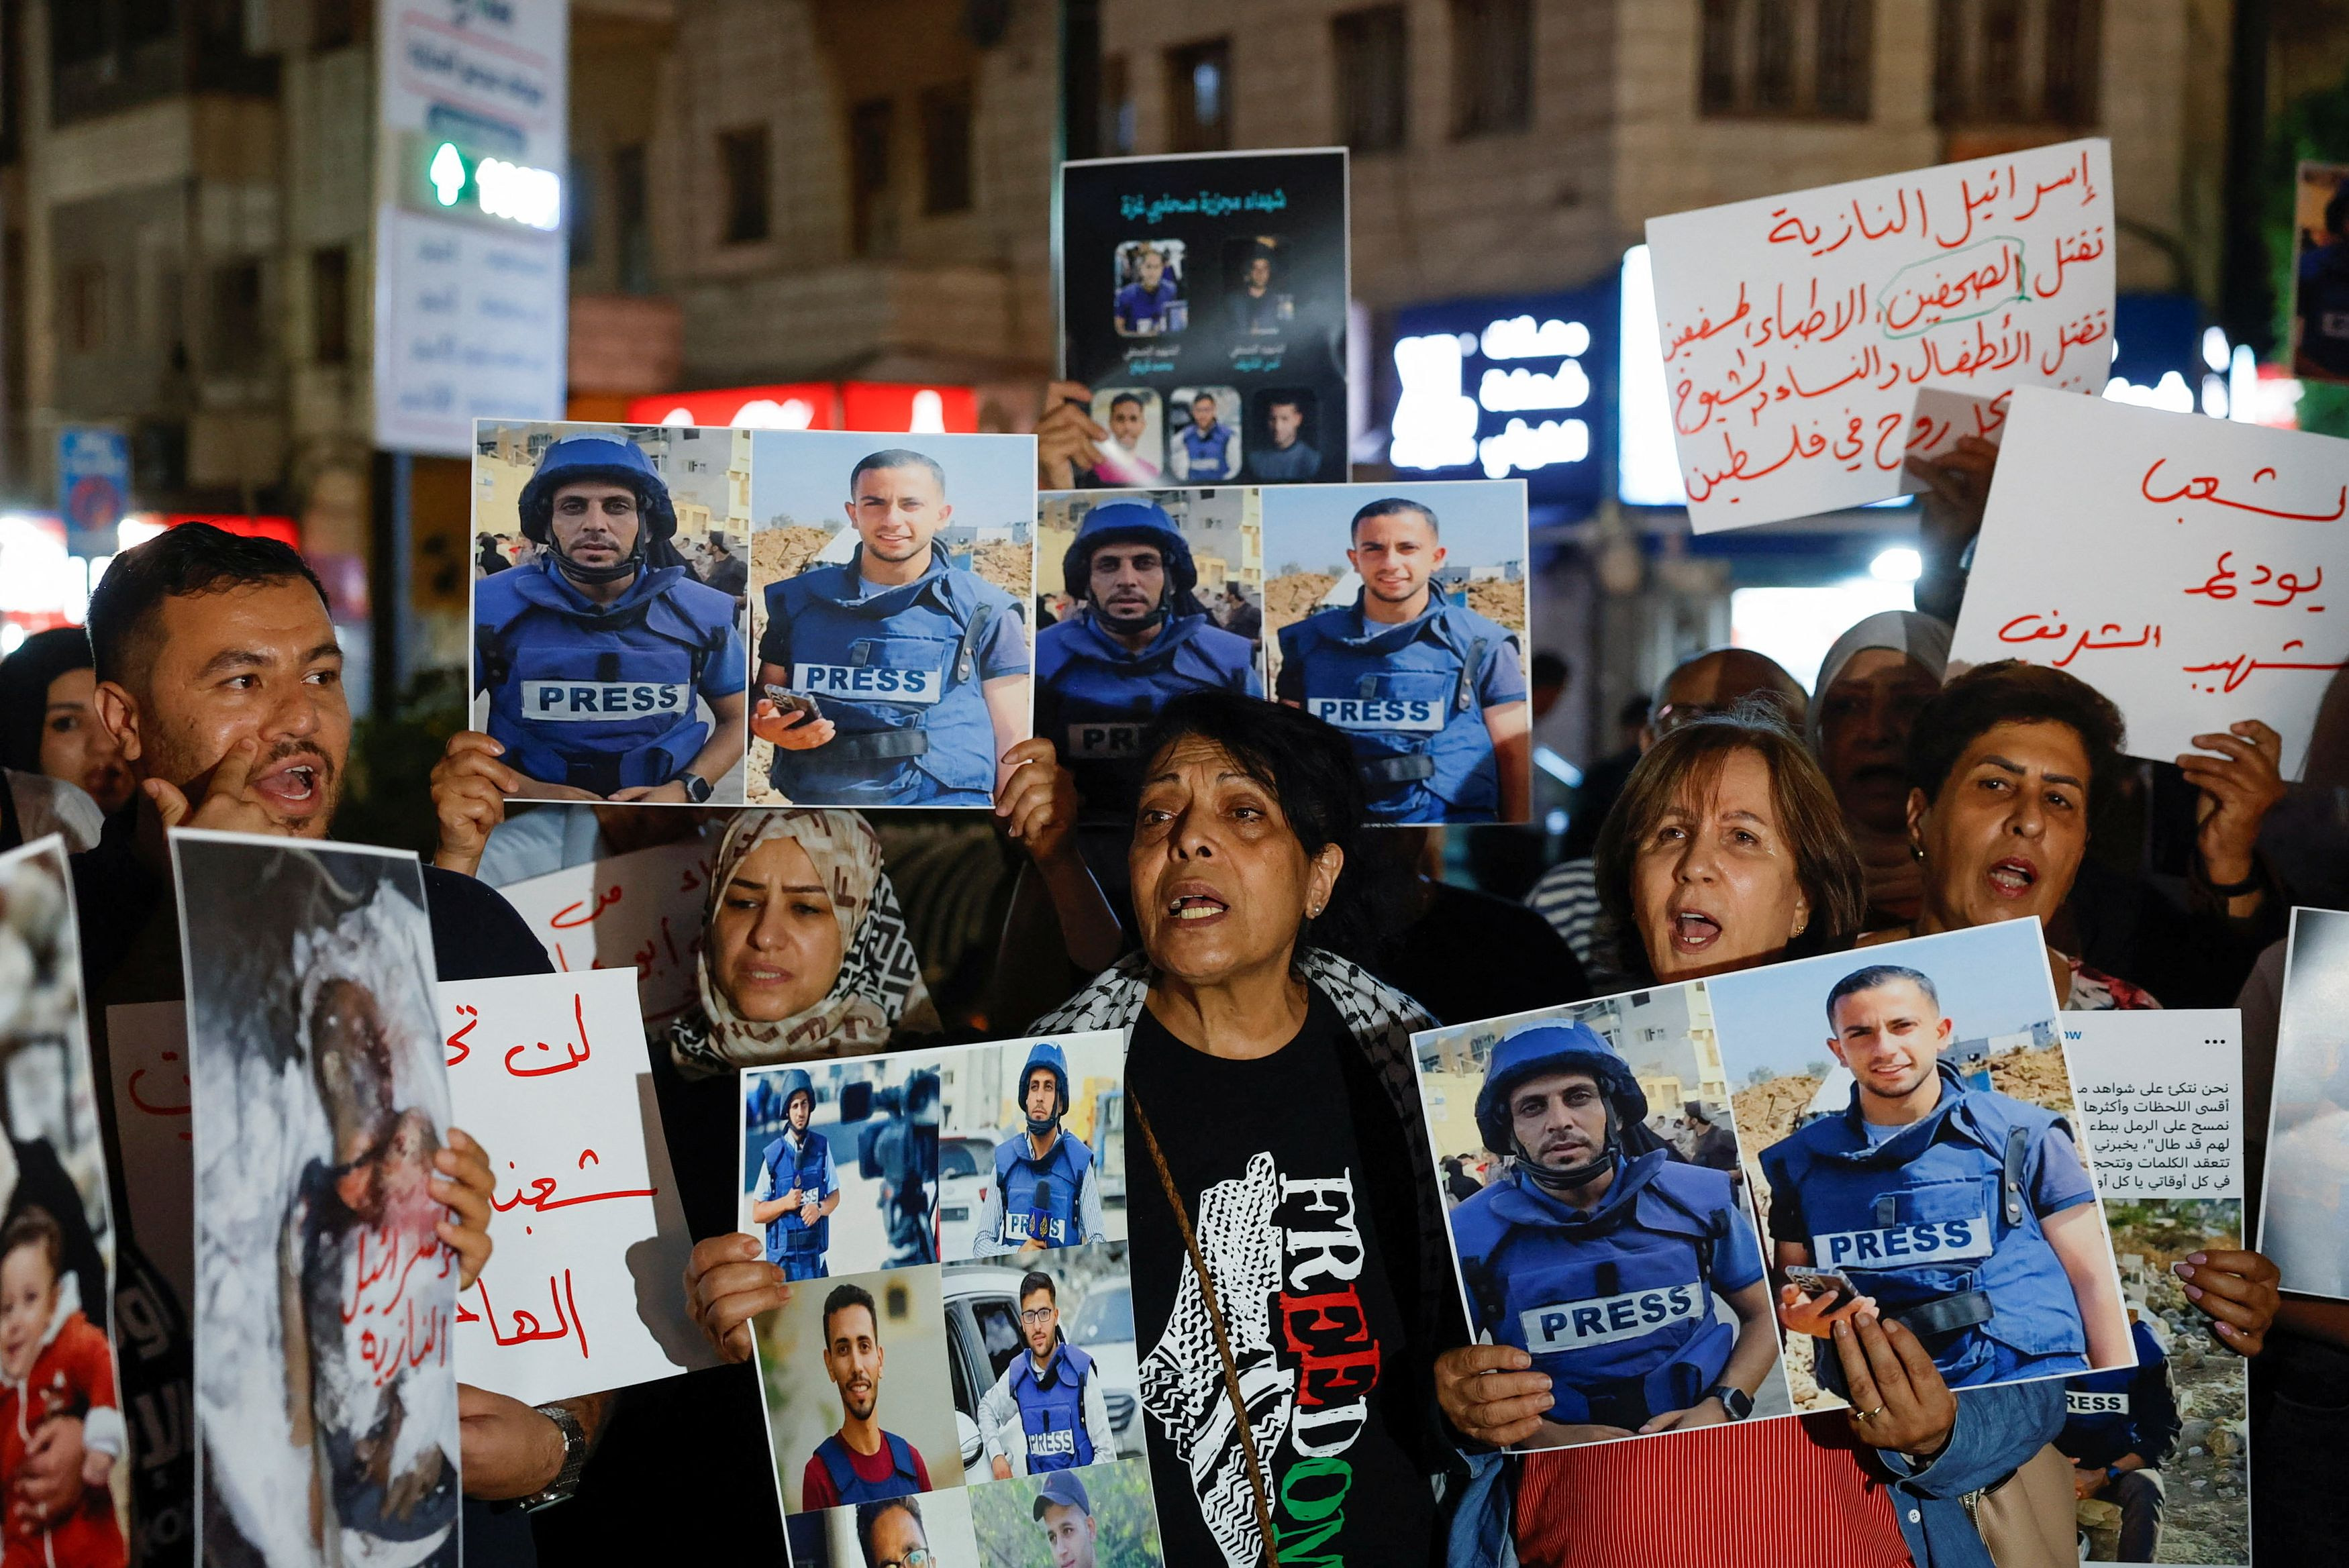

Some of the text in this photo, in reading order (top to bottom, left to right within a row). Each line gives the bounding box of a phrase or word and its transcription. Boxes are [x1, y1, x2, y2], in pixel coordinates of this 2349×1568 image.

[1767, 189, 1927, 256] النازية
[2034, 227, 2104, 297] تقتل
[1909, 313, 2031, 383] الأطفال
[2041, 309, 2107, 375] تقتل
[1833, 408, 1863, 471] في
[1874, 413, 1950, 470] روح
[1685, 420, 1826, 503] فلسطين
[806, 667, 926, 692] PRESS
[540, 684, 678, 712] PRESS
[1320, 700, 1430, 722] PRESS
[505, 993, 590, 1077] لن
[2093, 1082, 2135, 1096] شواهد
[2140, 1082, 2164, 1096] على
[2168, 1082, 2197, 1096] نتكئ
[2202, 1083, 2229, 1096] نحن
[2084, 1098, 2229, 1115] أقسى اللحظات وأكثرها
[2090, 1119, 2229, 1135] نمسح على الرمل ببطء
[2095, 1139, 2138, 1153] يخبرني
[2185, 1139, 2201, 1149] قد
[2206, 1138, 2230, 1153] لهم
[2138, 1157, 2188, 1168] الكلمات
[2193, 1158, 2230, 1168] تتعقد
[2112, 1175, 2130, 1189] كل
[2134, 1175, 2143, 1190] يا
[2148, 1174, 2187, 1190] أوقاتي
[2192, 1175, 2209, 1189] كل
[2214, 1175, 2230, 1191] في
[1011, 1215, 1060, 1236] PRS
[1830, 1219, 1972, 1263] PRESS
[1540, 1286, 1691, 1342] PRESS
[361, 1298, 446, 1387] النازية
[2066, 1395, 2121, 1410] RESS
[1030, 1430, 1072, 1451] PRESS
